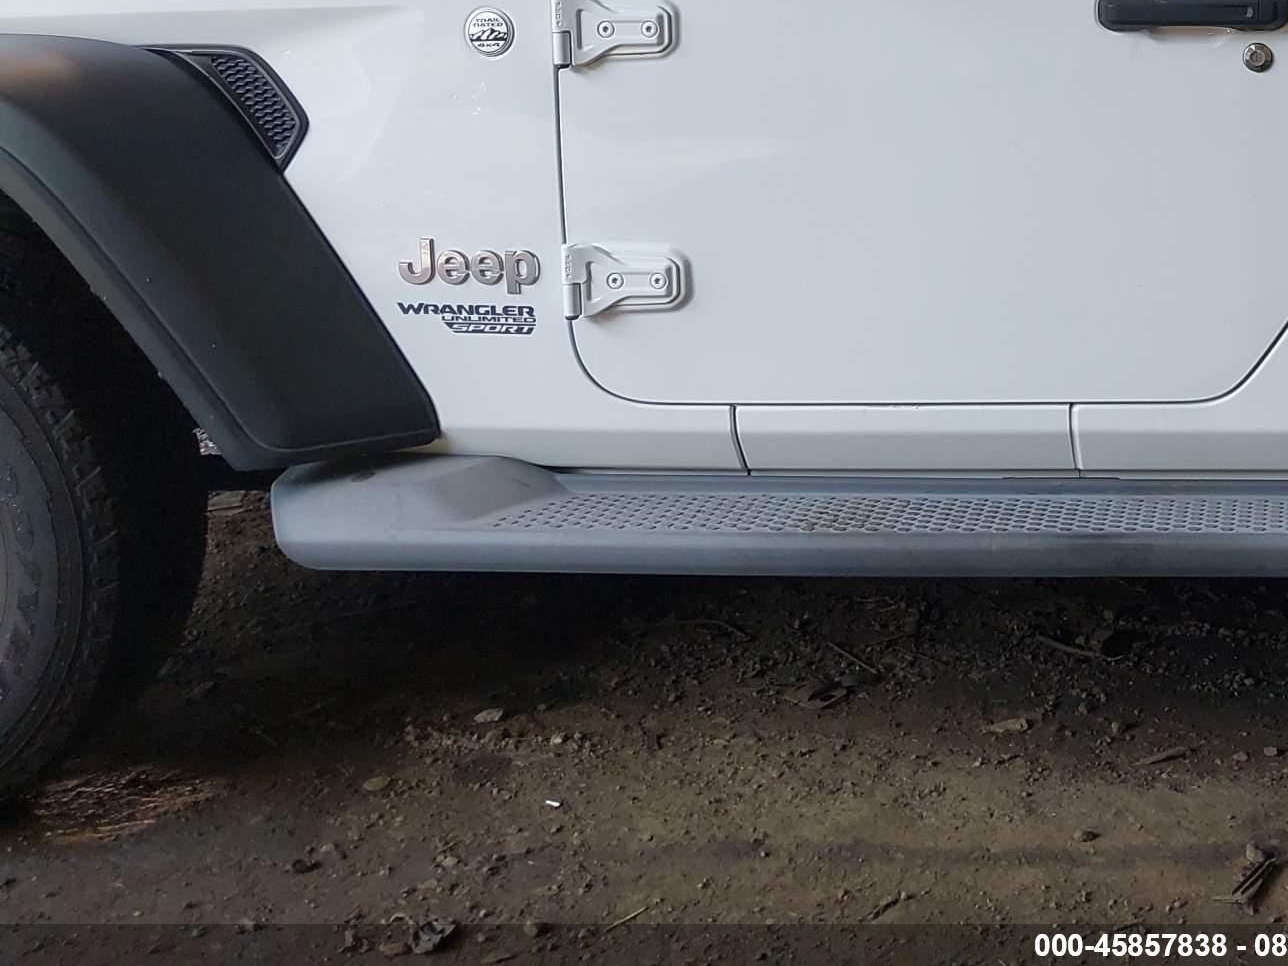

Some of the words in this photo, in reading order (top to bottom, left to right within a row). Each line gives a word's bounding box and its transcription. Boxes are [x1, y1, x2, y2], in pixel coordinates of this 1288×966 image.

[398, 238, 541, 295] Jeep
[397, 302, 536, 317] WRANGLER
[441, 315, 536, 323] UNLIMITED
[449, 323, 535, 333] SPORT
